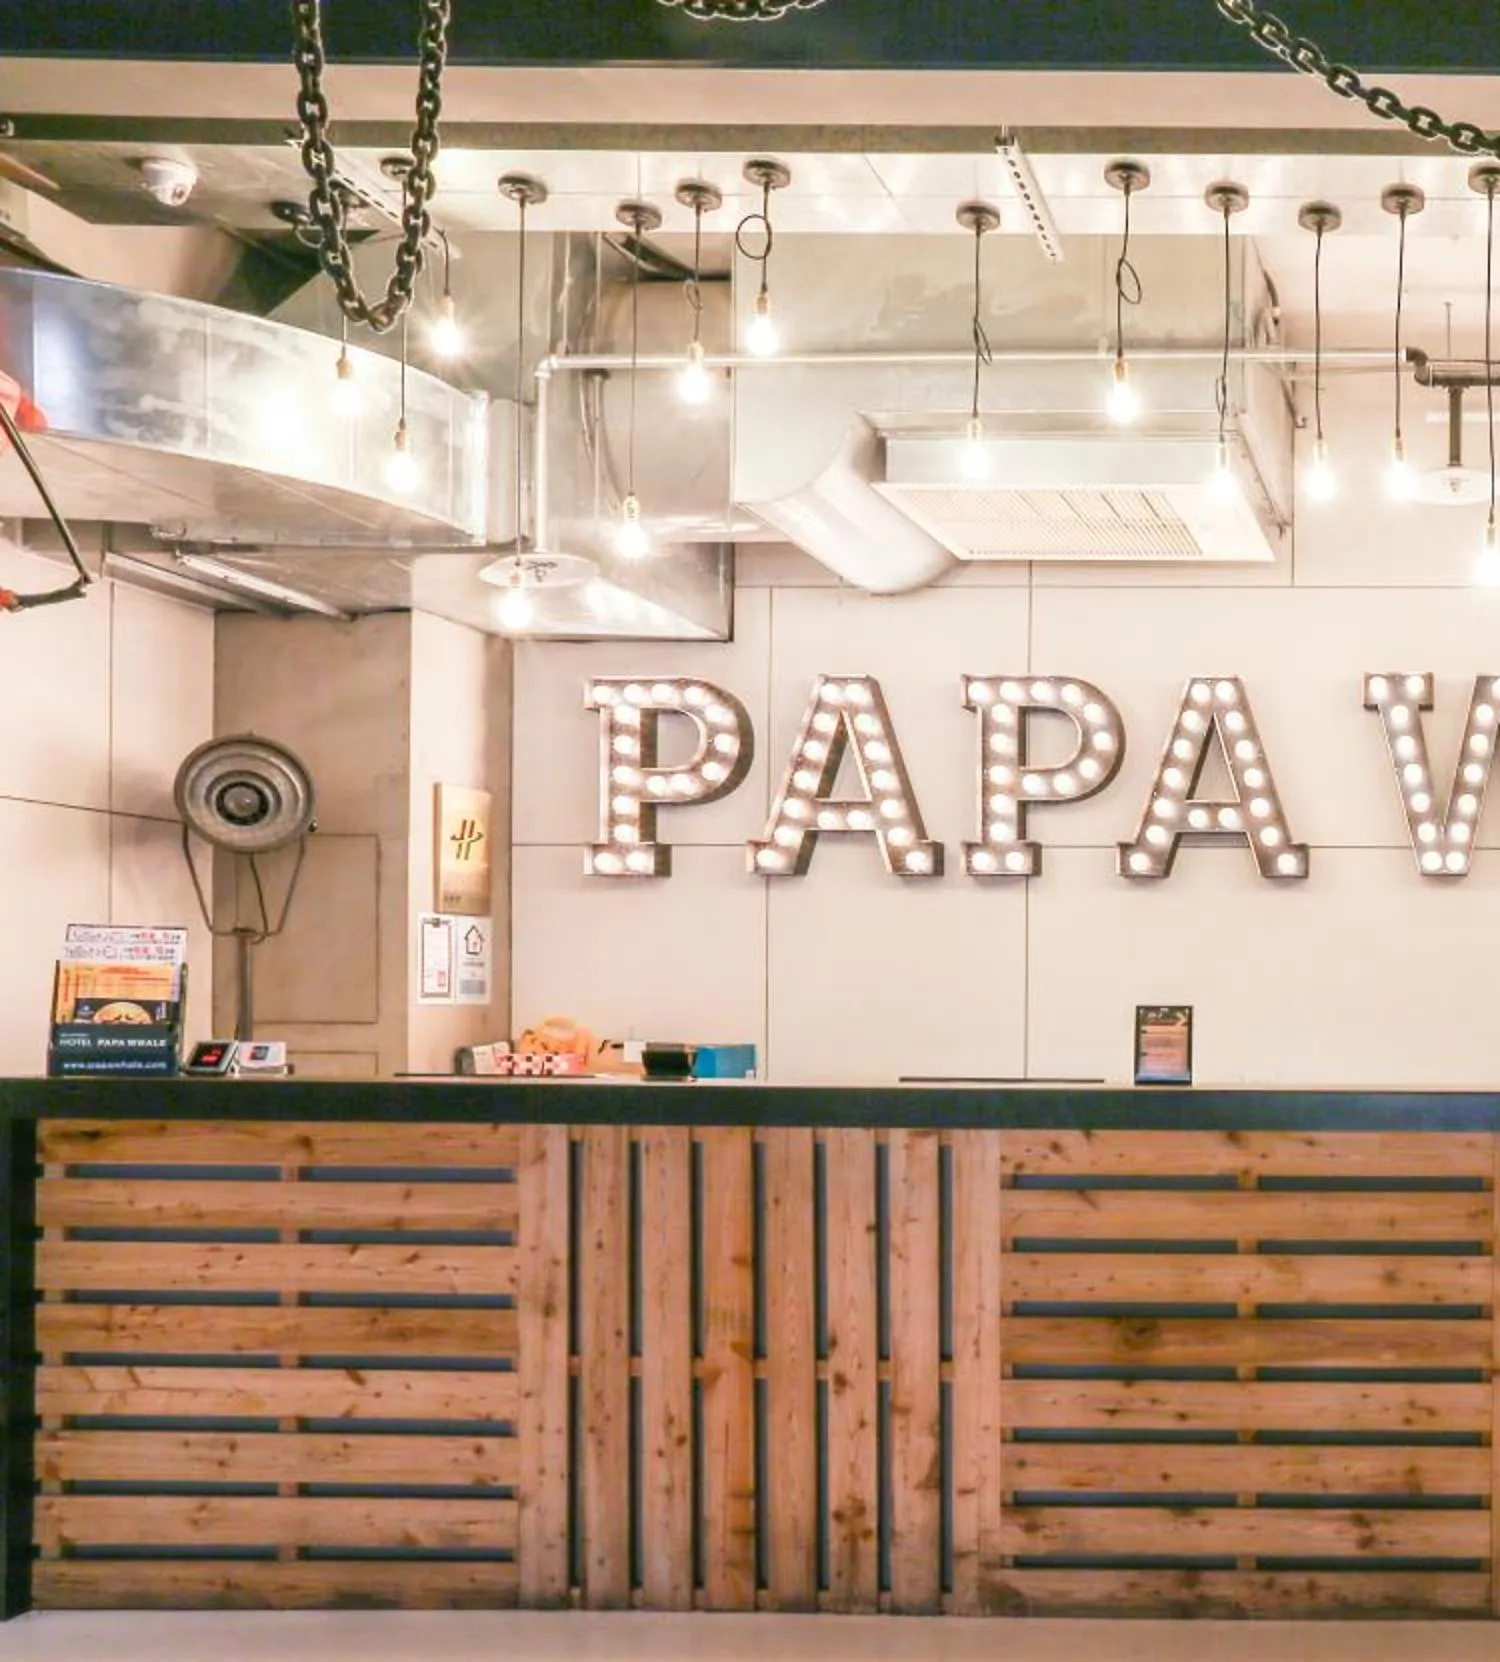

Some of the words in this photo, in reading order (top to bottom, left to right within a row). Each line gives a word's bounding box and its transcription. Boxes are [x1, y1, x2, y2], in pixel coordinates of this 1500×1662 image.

[582, 674, 1310, 878] PAPA
[58, 1038, 92, 1047] HOTEL
[97, 1038, 126, 1048] PAPA
[127, 1038, 167, 1048] WHALE
